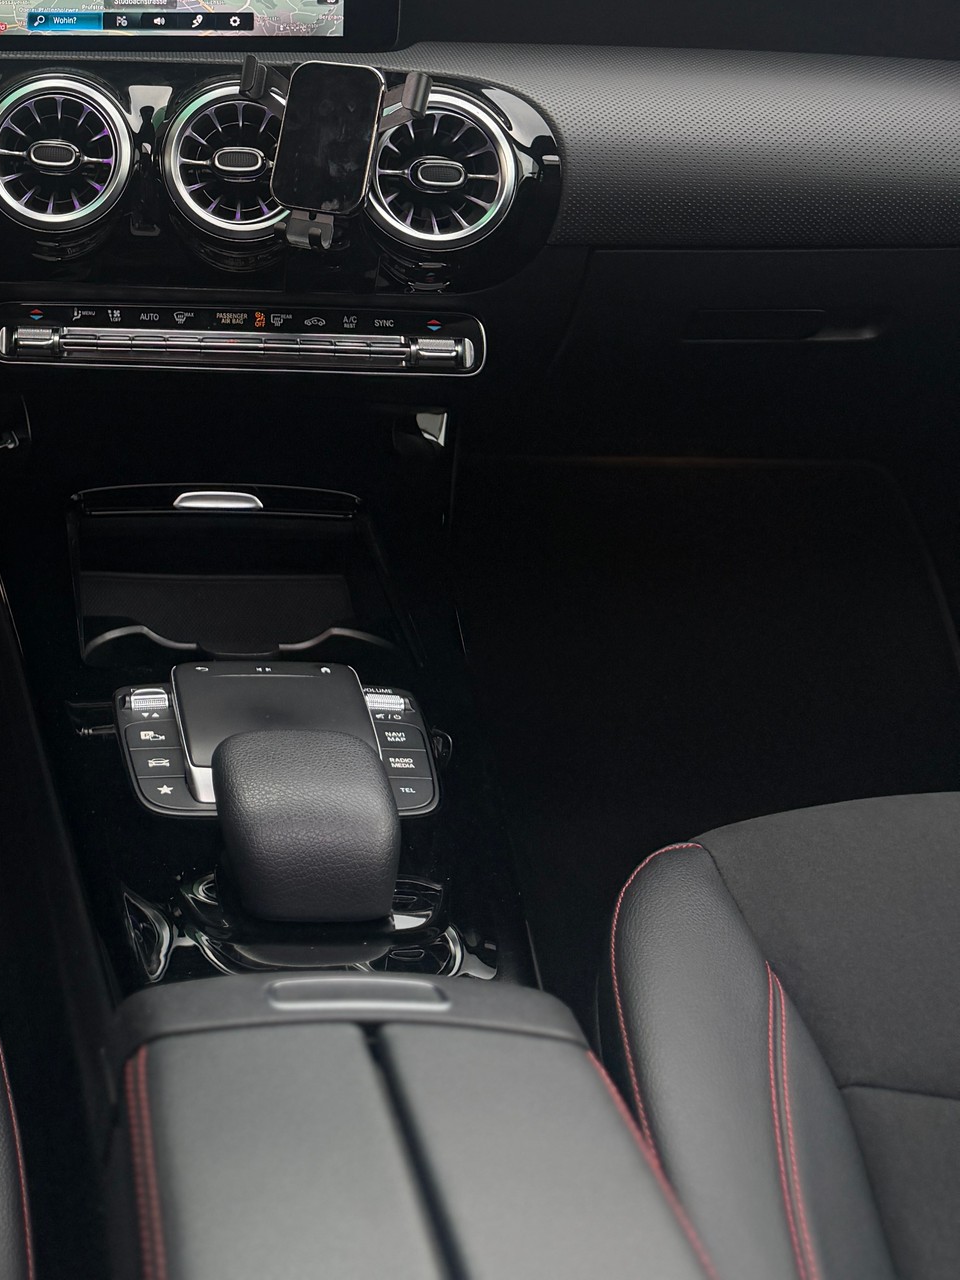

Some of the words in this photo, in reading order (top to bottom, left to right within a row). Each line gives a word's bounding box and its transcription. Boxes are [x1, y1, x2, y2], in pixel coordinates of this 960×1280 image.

[53, 16, 77, 24] Wohin?
[140, 313, 159, 321] AUTO
[374, 319, 394, 327] SYNC
